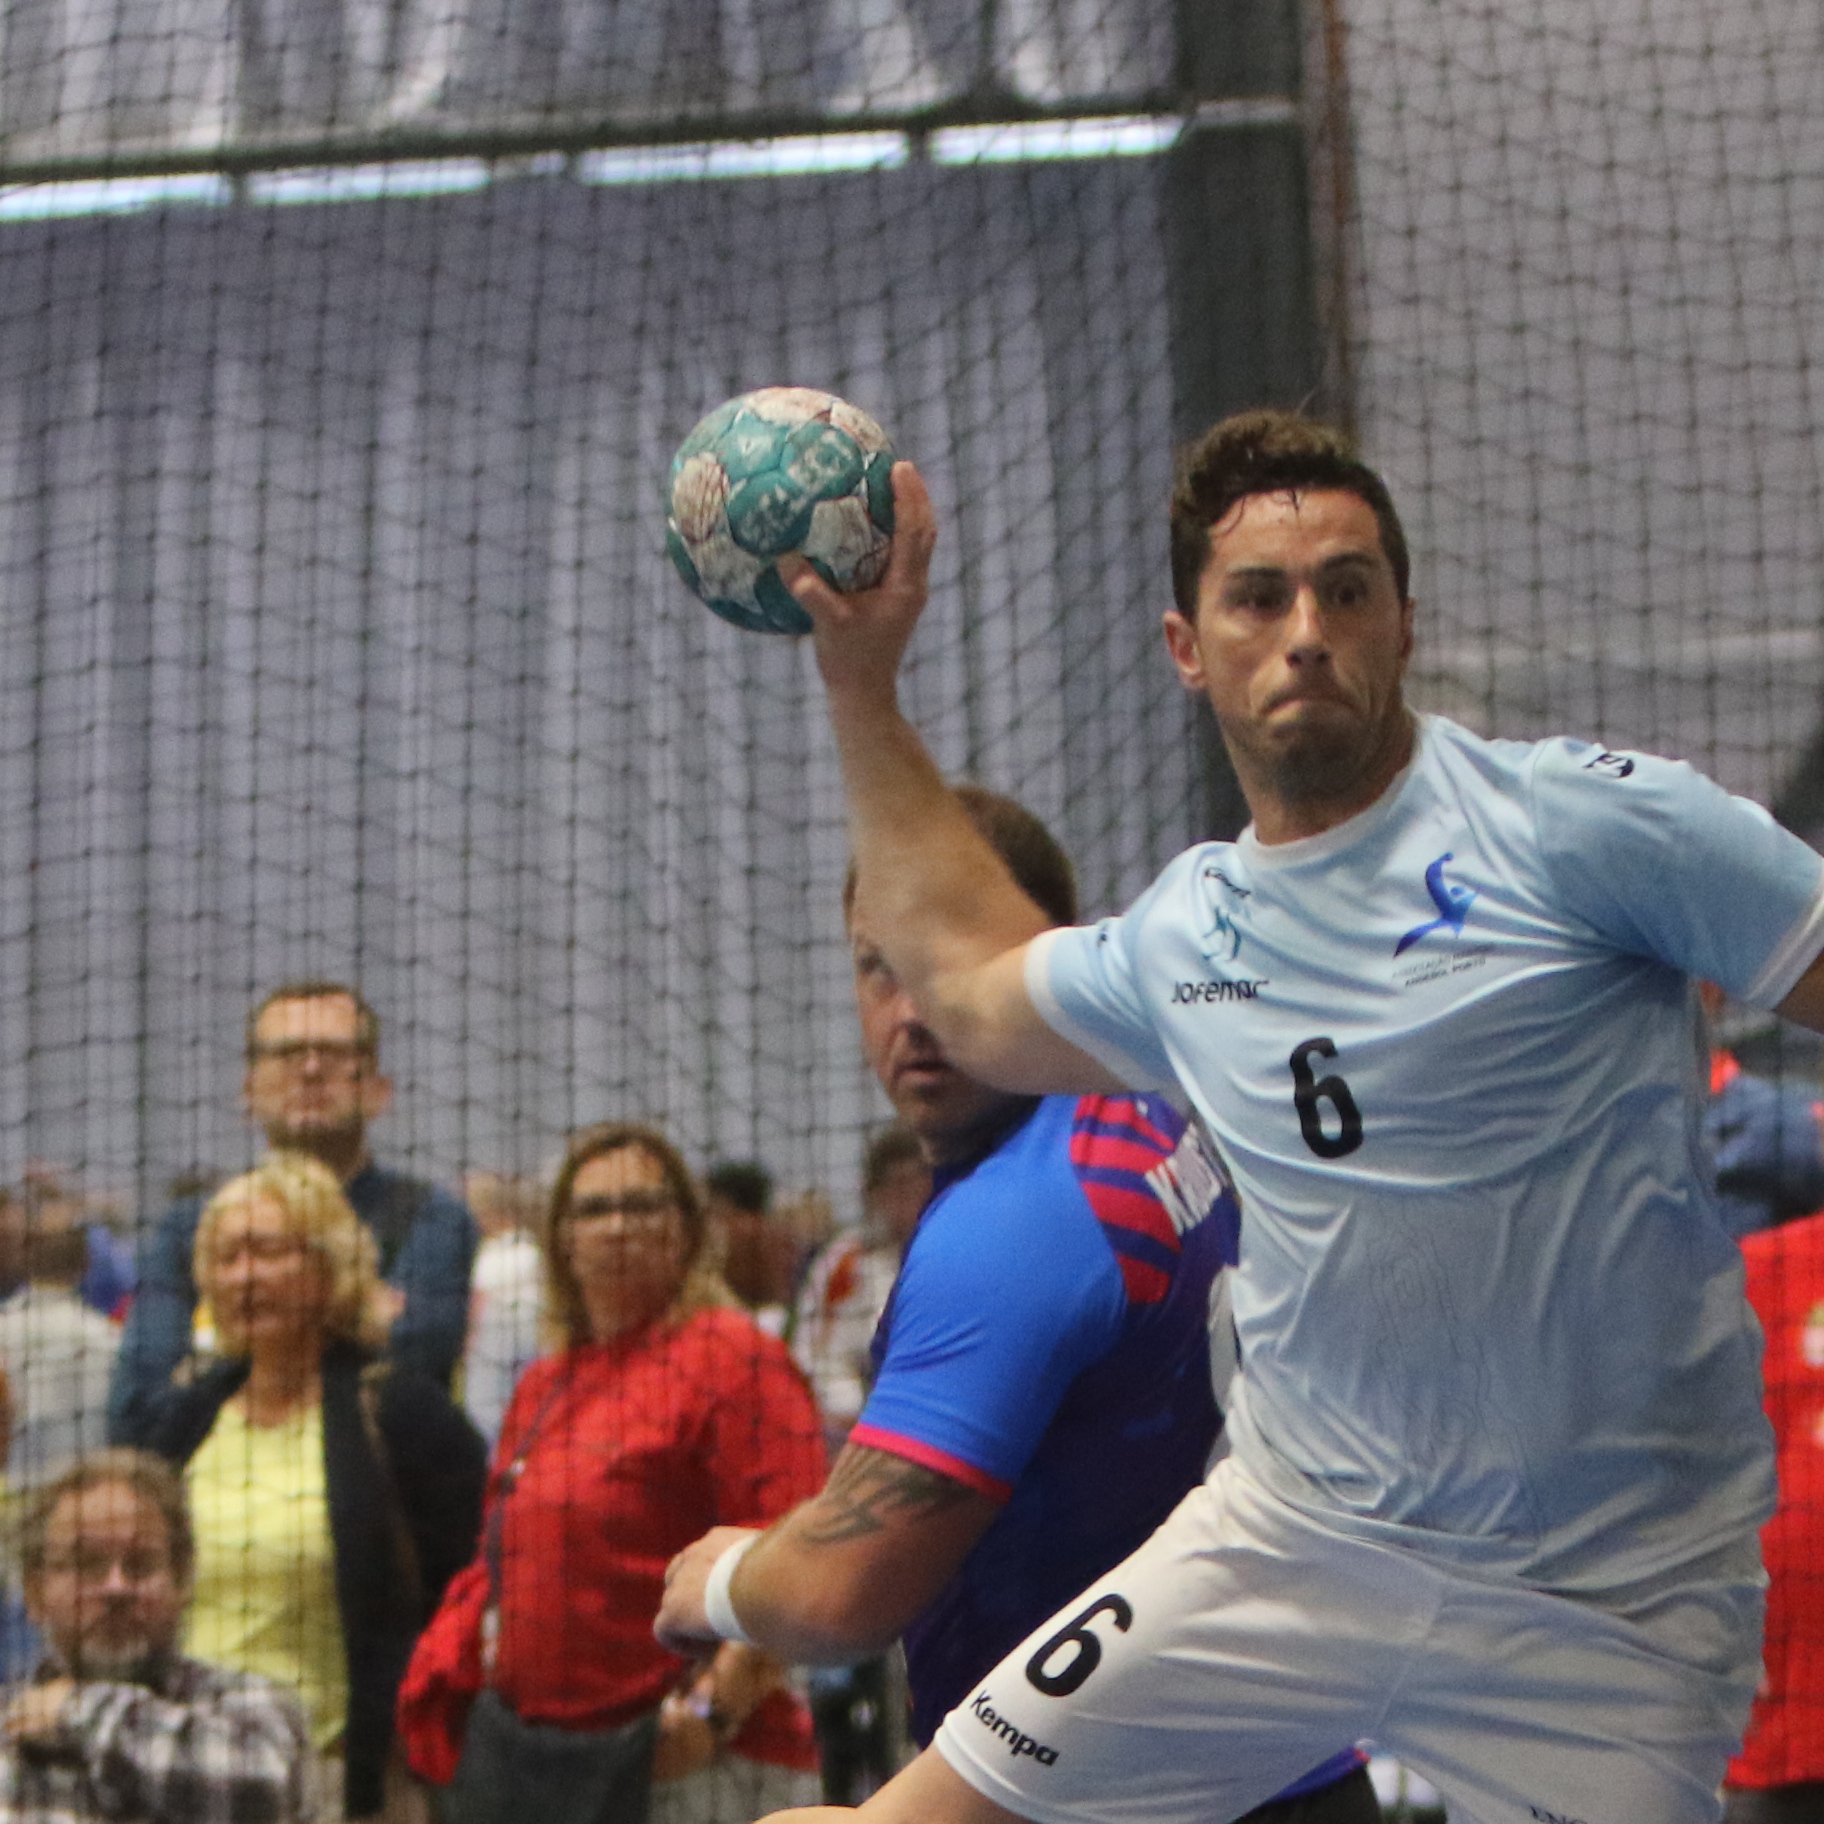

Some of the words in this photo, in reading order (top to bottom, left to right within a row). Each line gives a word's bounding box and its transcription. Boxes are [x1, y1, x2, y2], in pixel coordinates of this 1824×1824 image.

[1290, 1037, 1363, 1158] 6
[1025, 1593, 1133, 1698] 6
[970, 1688, 1060, 1767] Kempa
